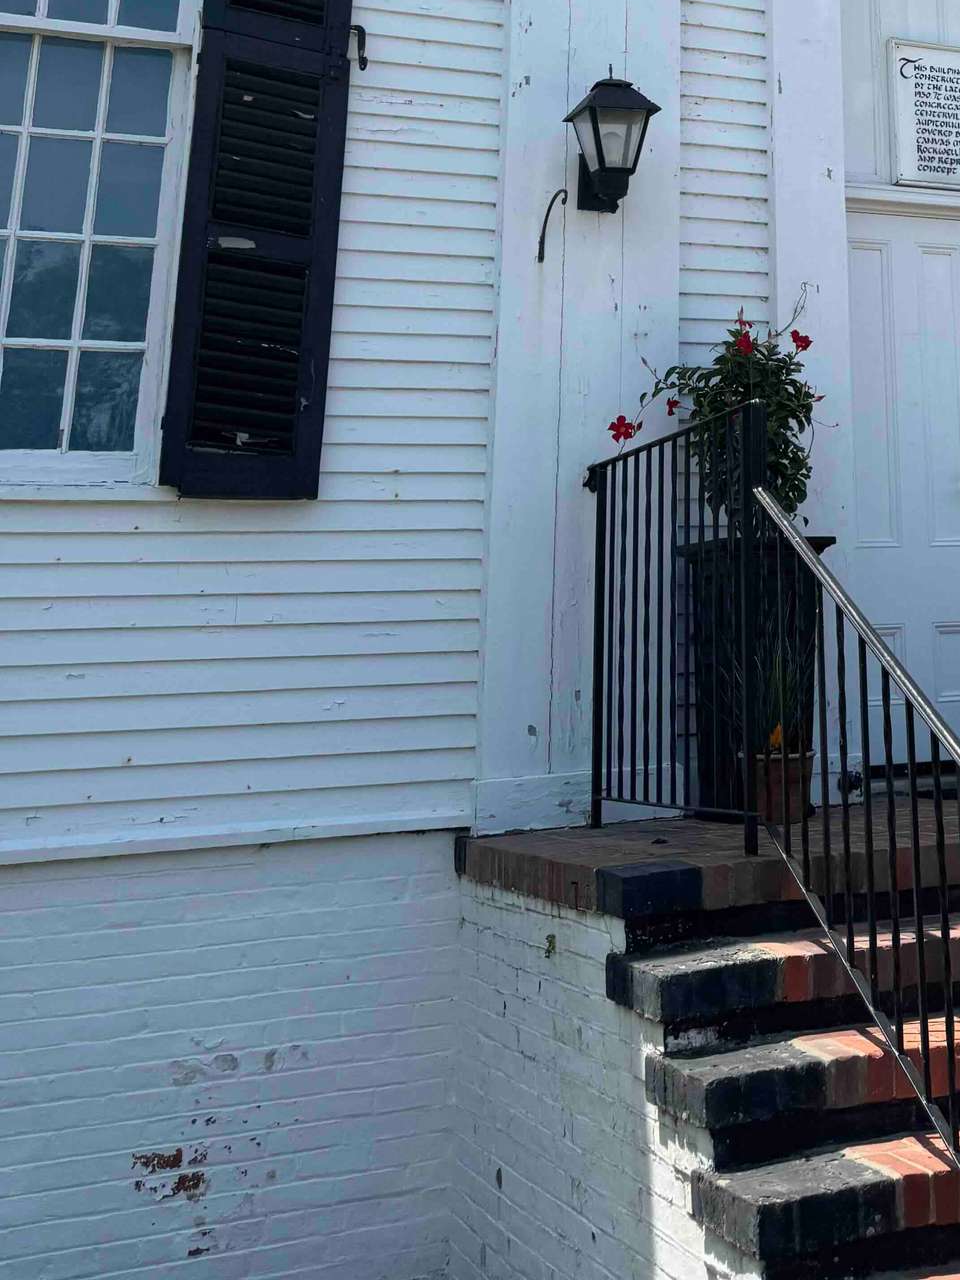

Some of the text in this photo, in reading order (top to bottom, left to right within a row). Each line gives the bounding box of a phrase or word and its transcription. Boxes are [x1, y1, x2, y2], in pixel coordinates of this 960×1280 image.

[899, 58, 927, 79] THIS
[916, 128, 952, 137] COVERED
[917, 137, 950, 146] CANVAS
[917, 145, 958, 157] ROCKWELL
[918, 155, 935, 163] AND
[918, 164, 957, 176] CONCEPT
